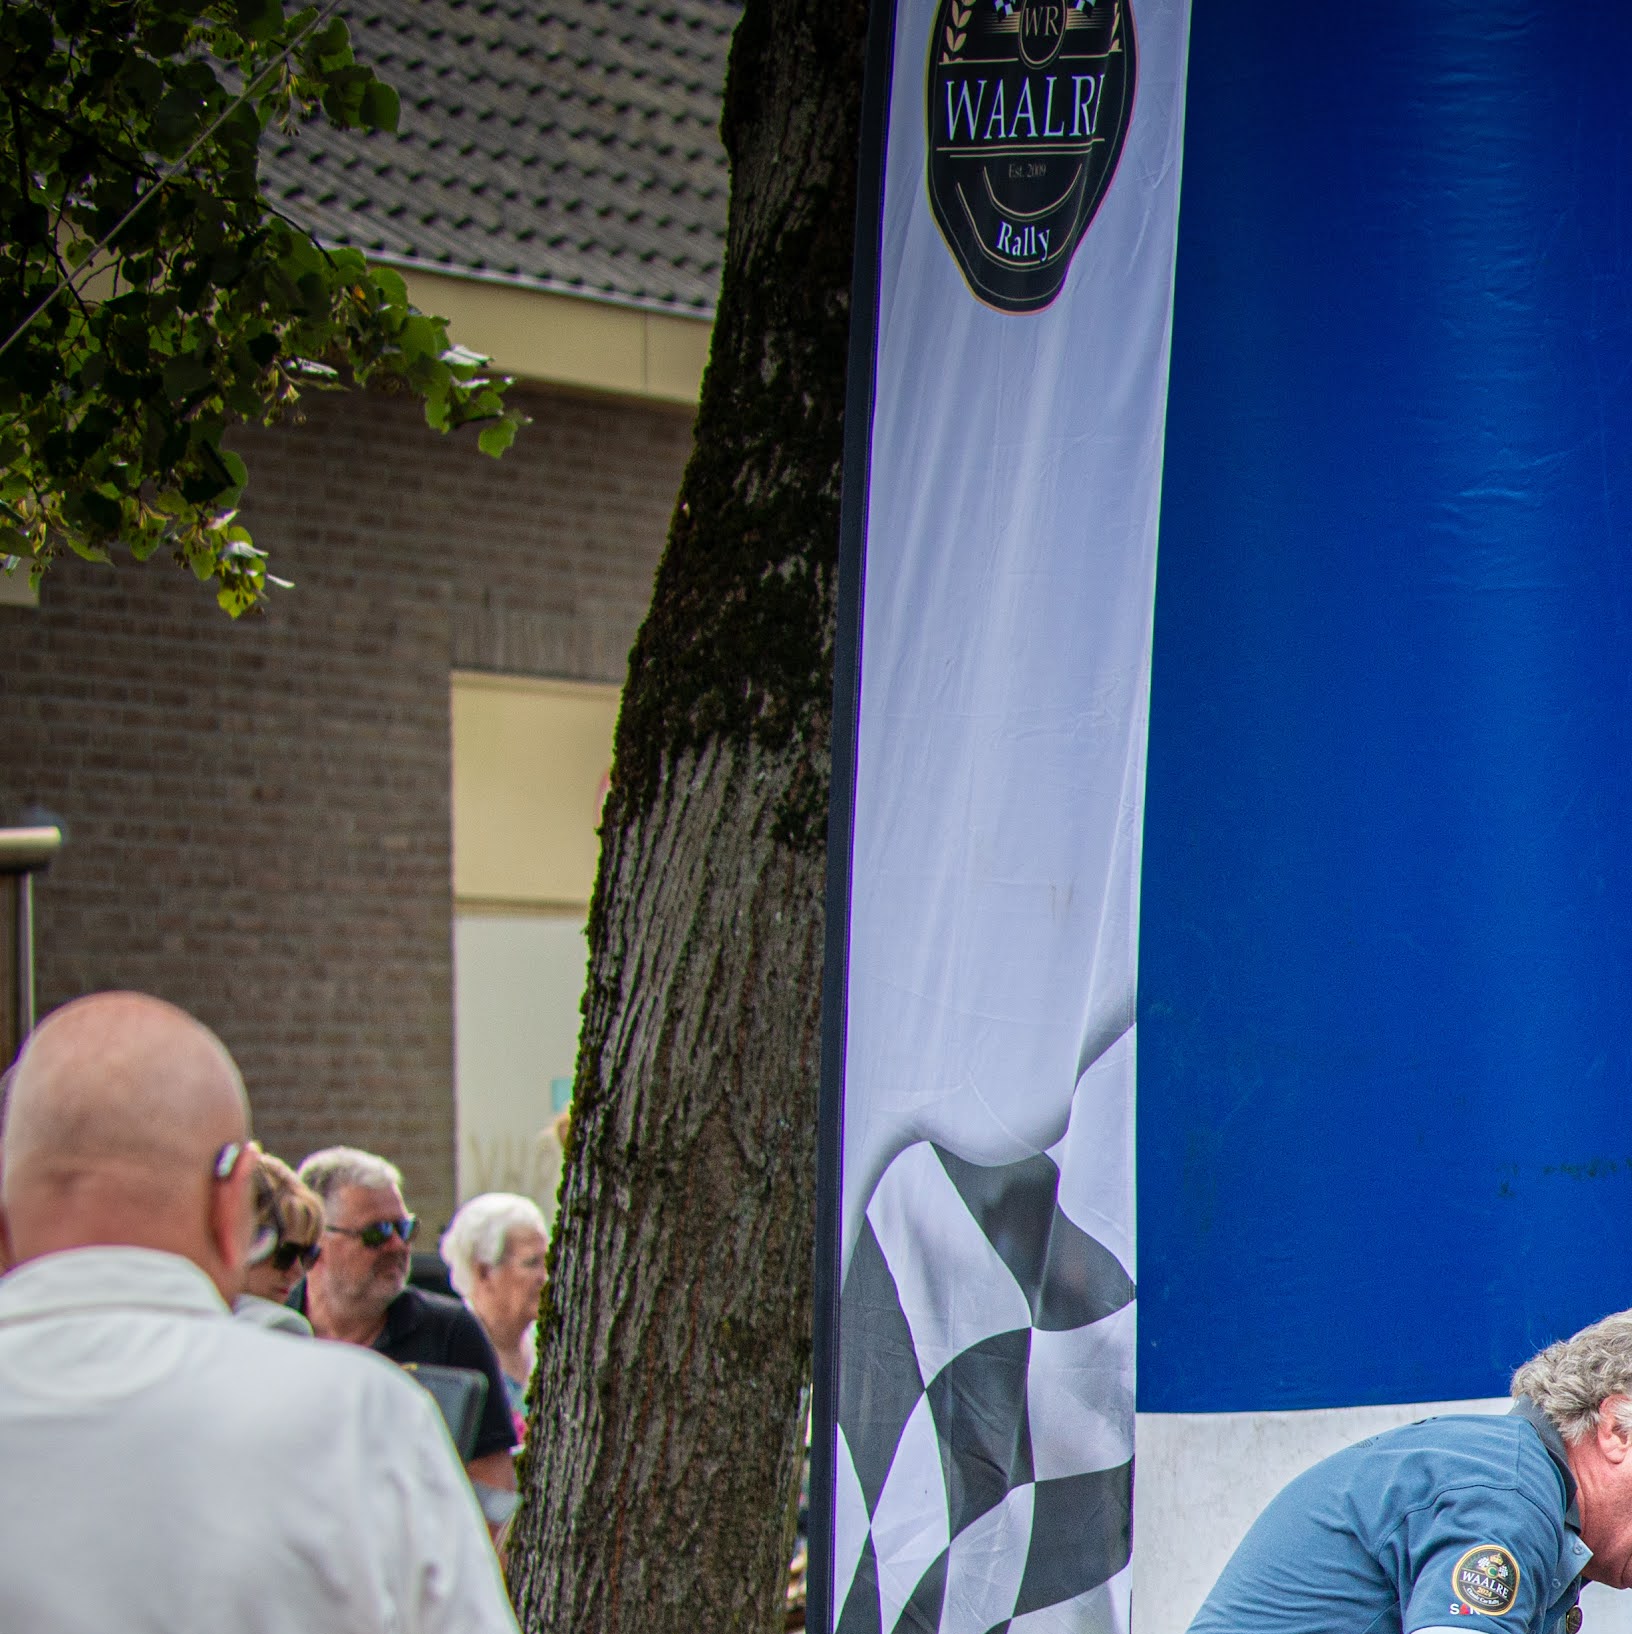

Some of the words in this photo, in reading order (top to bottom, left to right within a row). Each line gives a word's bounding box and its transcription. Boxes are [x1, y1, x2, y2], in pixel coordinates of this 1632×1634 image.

[1025, 6, 1058, 36] WR
[997, 221, 1050, 262] Rally
[1462, 1571, 1509, 1598] WAALRE
